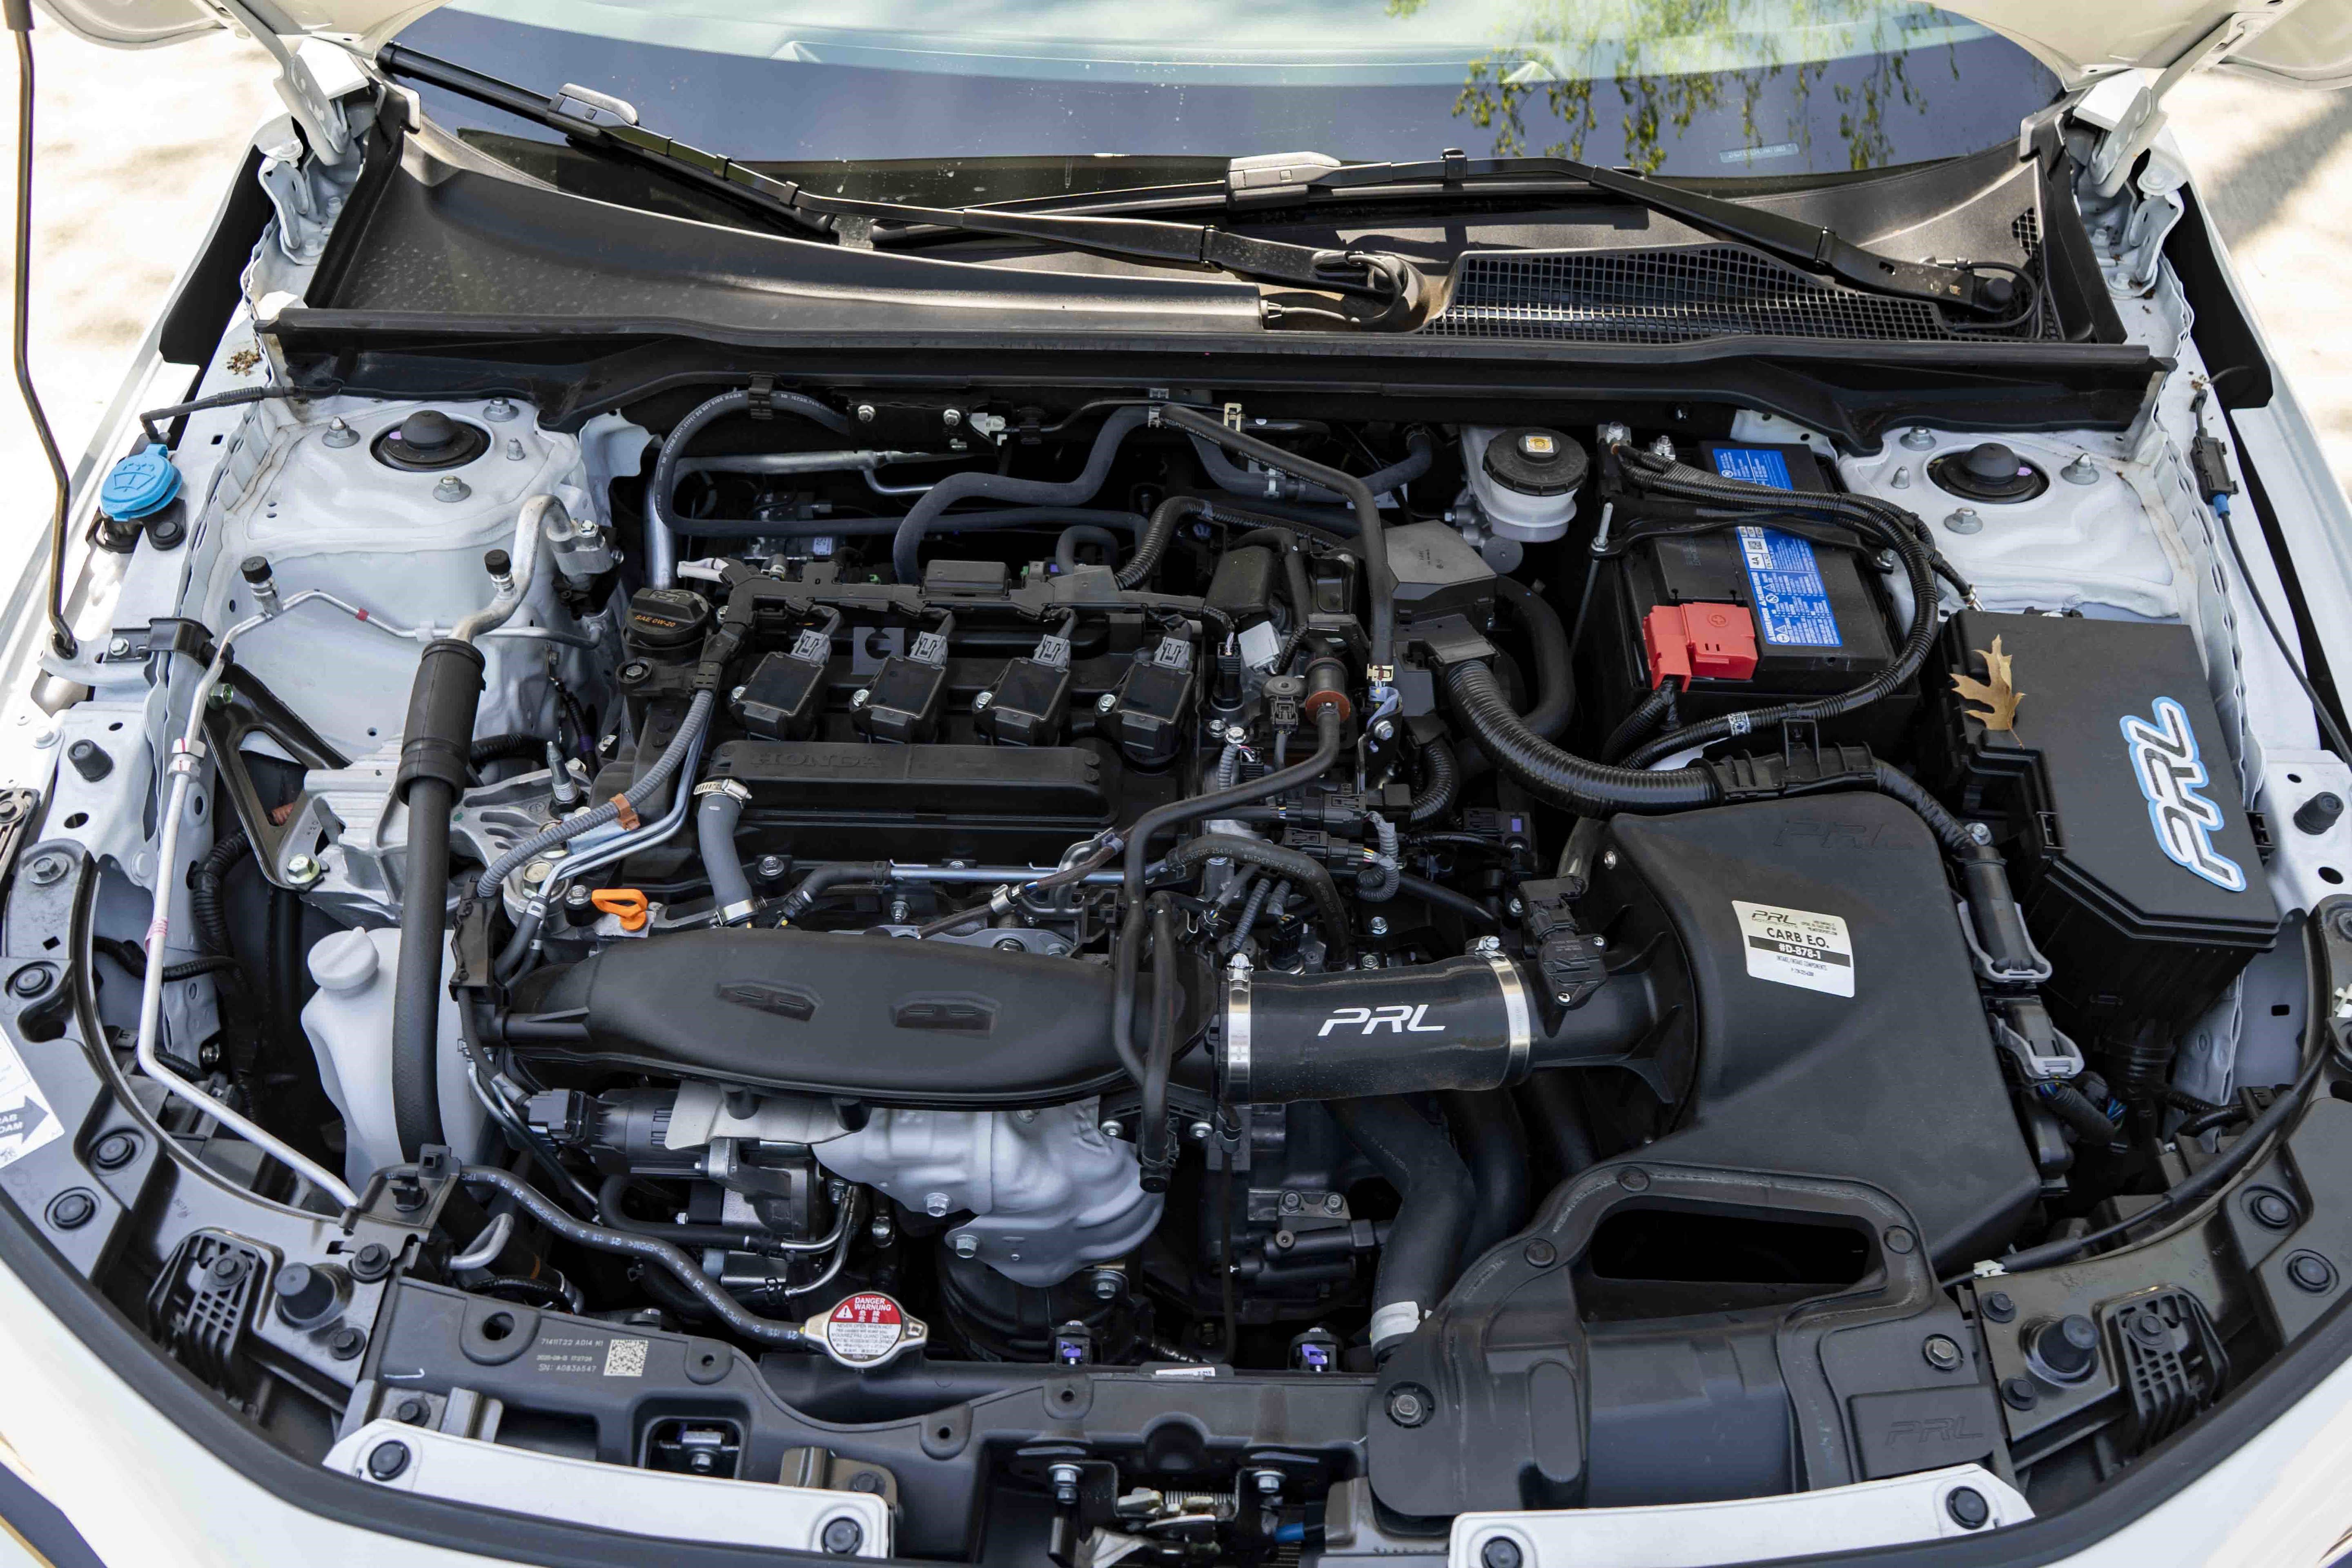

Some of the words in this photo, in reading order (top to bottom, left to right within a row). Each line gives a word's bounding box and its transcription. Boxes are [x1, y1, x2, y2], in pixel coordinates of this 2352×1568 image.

[1751, 557, 1759, 565] 4A
[652, 618, 676, 627] 0W-20
[2127, 702, 2240, 888] PRL
[1774, 818, 1912, 850] PRL
[1751, 910, 1797, 925] PRL
[1766, 927, 1802, 942] CARB
[1779, 943, 1821, 959] #D-878-1
[1317, 1004, 1446, 1036] PRL
[1884, 1417, 1985, 1446] PRL
